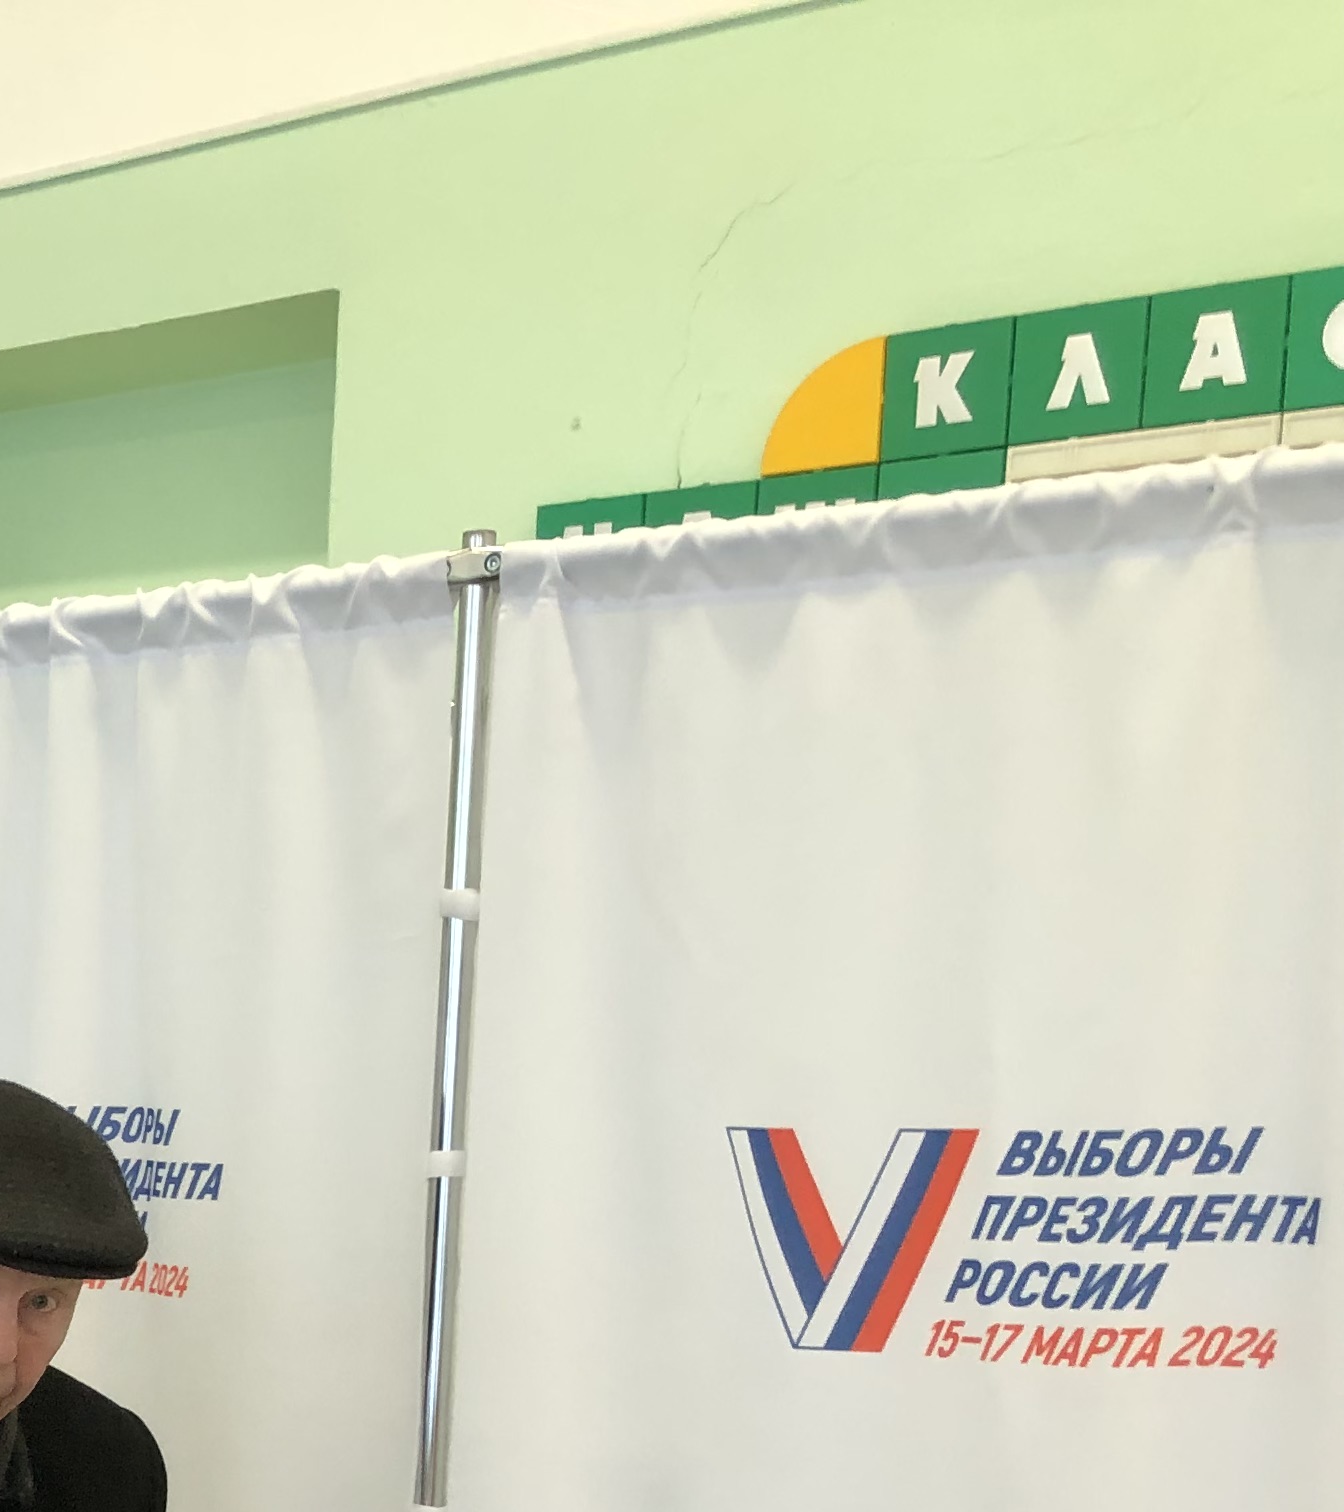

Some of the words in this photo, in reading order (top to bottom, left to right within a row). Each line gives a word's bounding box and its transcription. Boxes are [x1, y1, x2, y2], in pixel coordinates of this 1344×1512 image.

[996, 1126, 1266, 1177] ВЫБОРЫ
[118, 1157, 224, 1202] ИДЕНТА
[970, 1193, 1324, 1252] ПРЕЗИДЕНТА
[148, 1262, 189, 1299] 2024
[944, 1258, 1170, 1311] РОССИИ
[924, 1318, 1026, 1360] 15-17
[1023, 1324, 1166, 1369] МАРТА
[1167, 1325, 1279, 1370] 2024
